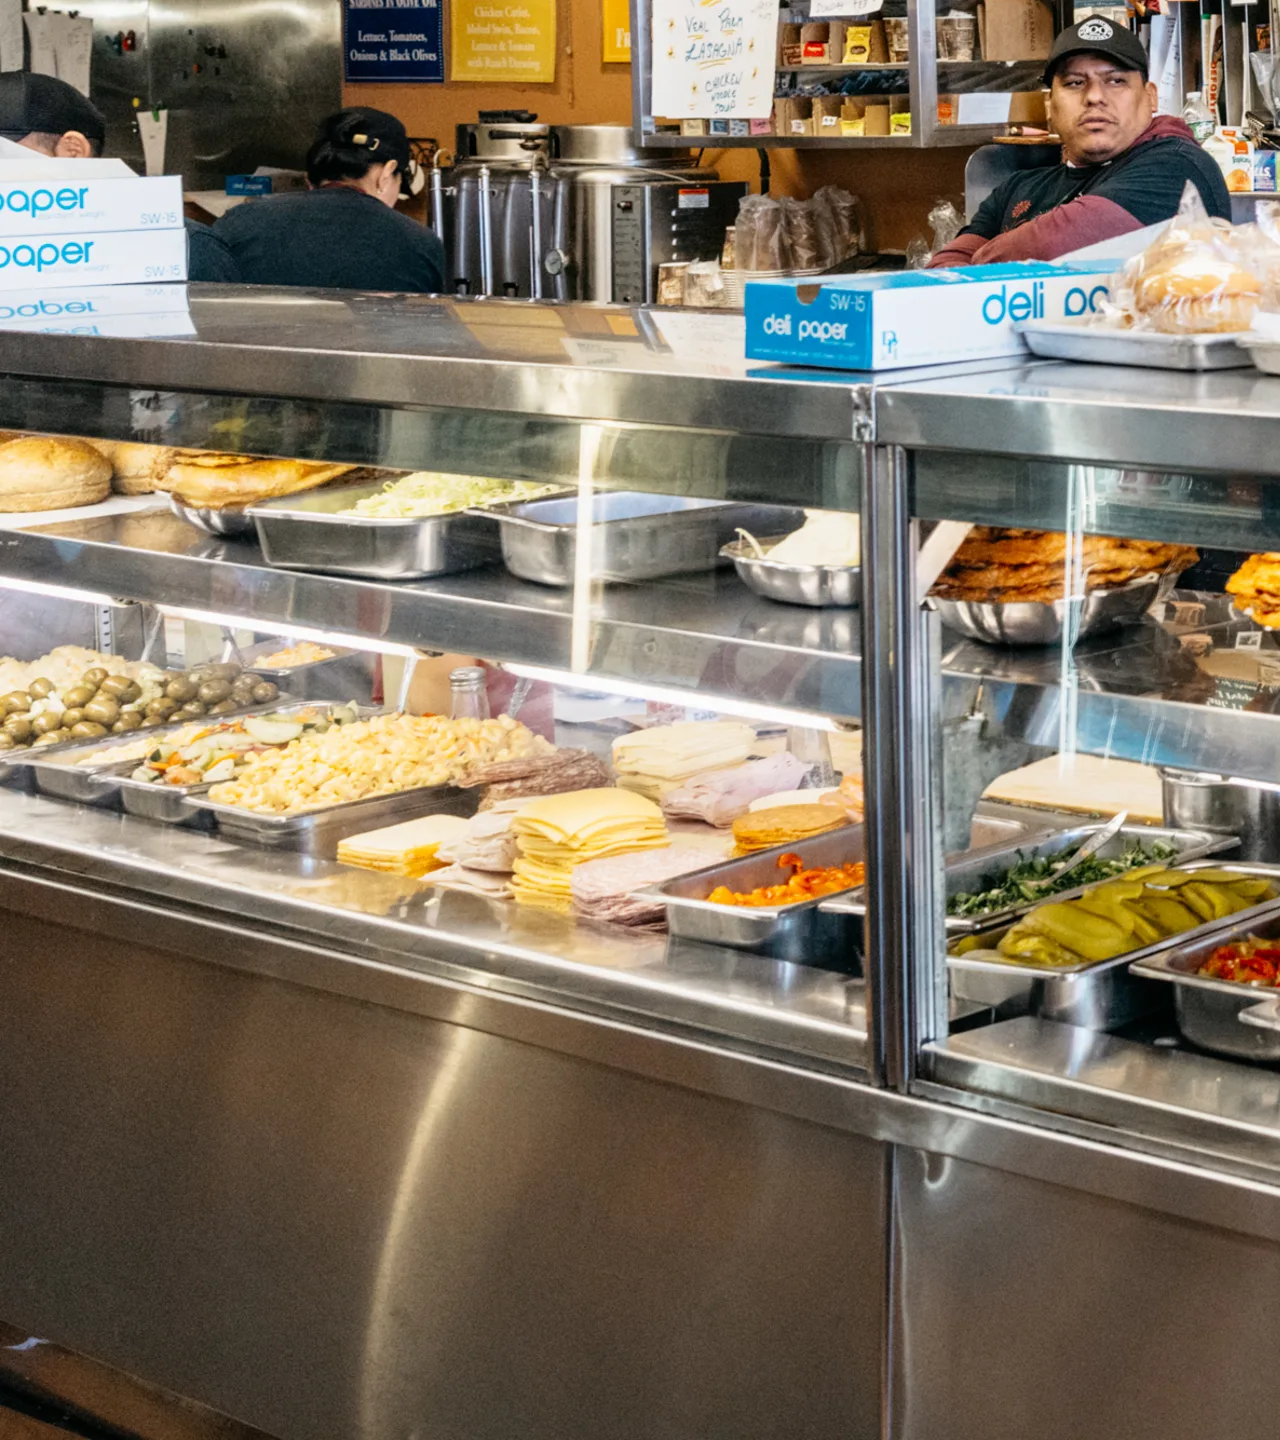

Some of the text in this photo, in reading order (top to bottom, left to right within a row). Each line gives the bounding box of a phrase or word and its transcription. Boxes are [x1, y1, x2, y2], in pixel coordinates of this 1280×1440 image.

[830, 293, 865, 312] SW-15
[763, 314, 848, 341] deli paper
